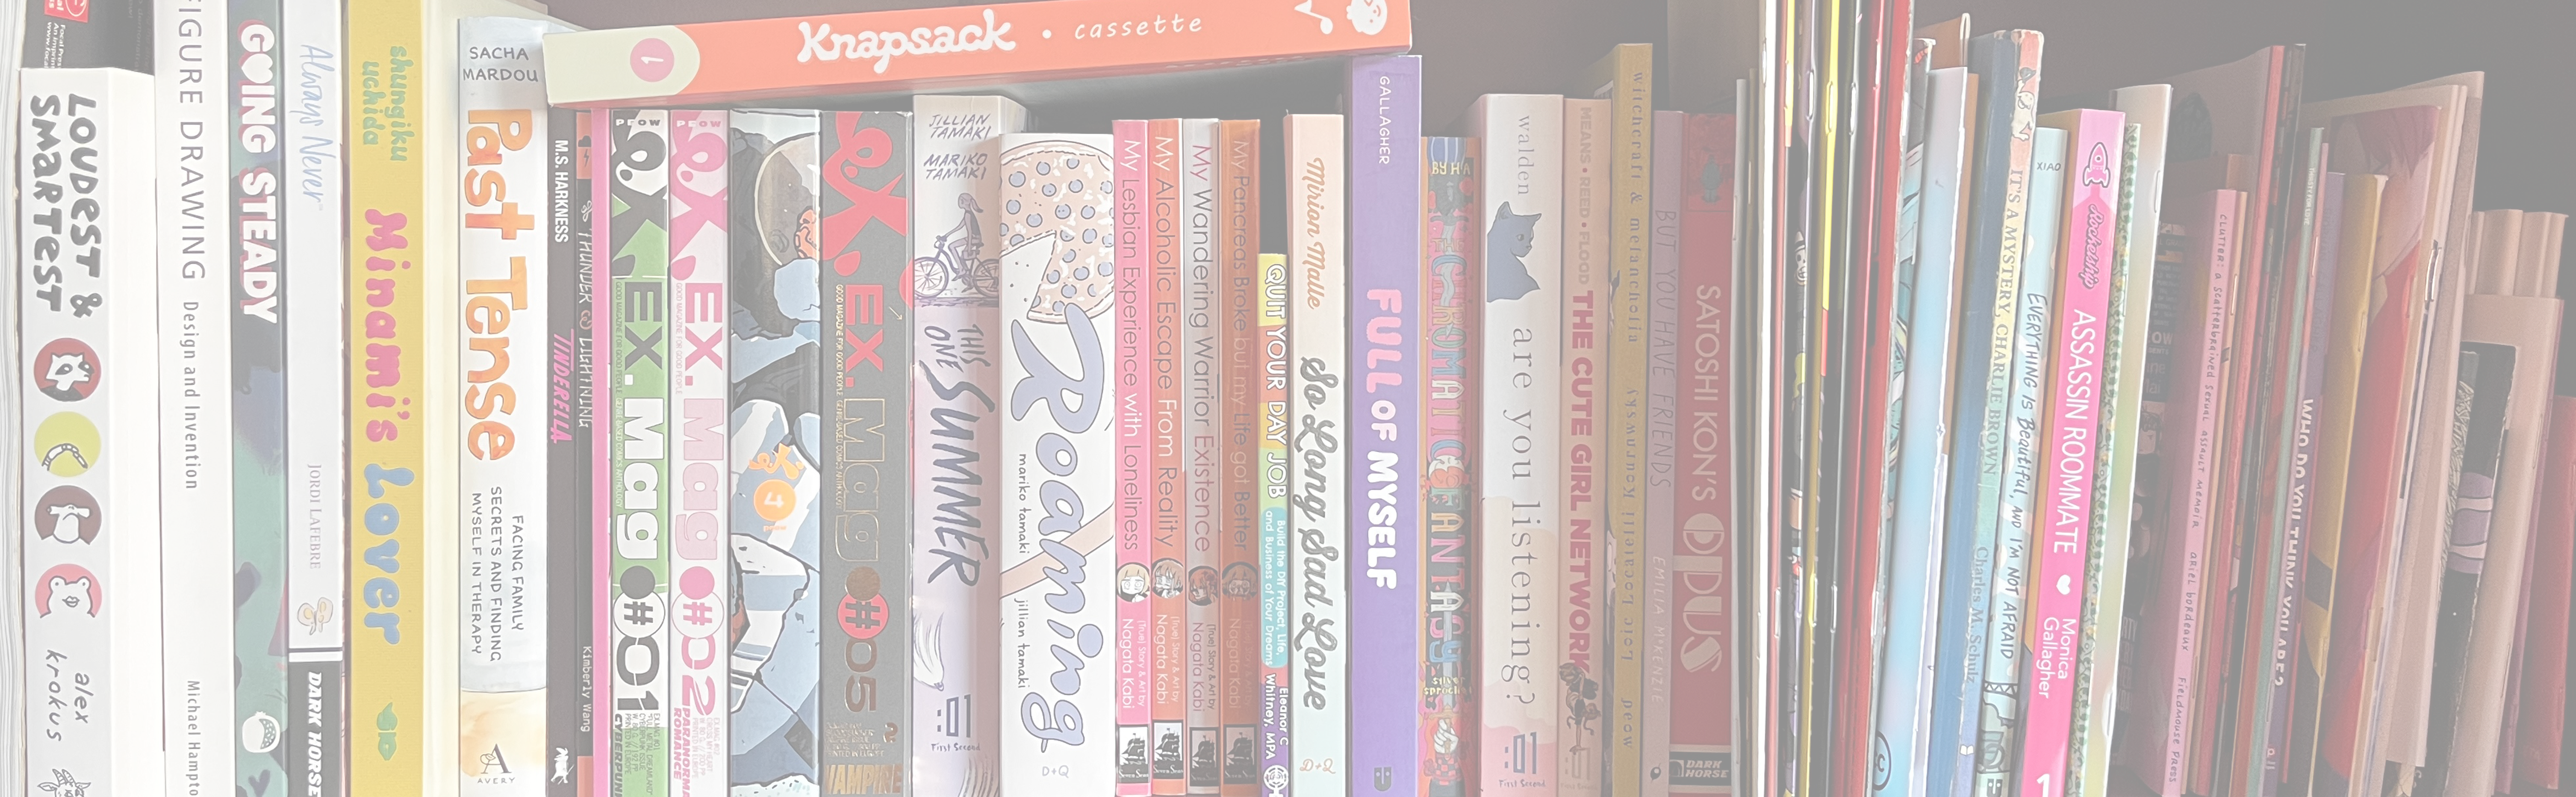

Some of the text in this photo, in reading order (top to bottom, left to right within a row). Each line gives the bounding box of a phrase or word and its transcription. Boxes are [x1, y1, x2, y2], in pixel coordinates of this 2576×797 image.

[463, 68, 538, 83] MARDOU
[469, 47, 528, 61] SACHA
[797, 8, 1016, 74] Knapsack
[1074, 12, 1203, 39] cassette
[290, 45, 336, 204] Always Never
[363, 62, 386, 145] uchida
[385, 46, 415, 161] shungiku
[929, 114, 990, 127] JILLIAN
[929, 126, 991, 139] TAMAKI
[1379, 76, 1390, 165] GALLAGHER
[1518, 115, 1534, 195] walden
[180, 121, 205, 279] DRAWING
[555, 139, 569, 243] M.S. HARKNESS
[924, 153, 987, 166] MARIKO
[925, 167, 987, 180] TAMAKI
[1579, 106, 1592, 285] MEANS REED FLOOD
[1628, 72, 1643, 343] witchcraft melancholia
[2036, 162, 2061, 170] XIAO
[238, 167, 278, 323] STEADY
[465, 109, 534, 460] Past Tense
[1302, 157, 1325, 310] Mirion Malle
[69, 294, 103, 318] &
[957, 323, 991, 367] THIS
[1119, 140, 1142, 550] My Lesbian Experience with Loneliness
[1152, 137, 1178, 547] My Alcoholic Escape From Reality
[1189, 145, 1215, 552] My Wandering Warrior Existence
[1231, 141, 1251, 551] My Pancreas Broke Life Better
[1650, 210, 1676, 488] BUT YOU HAVE FRIENDS
[1984, 170, 2023, 475] IT'S A MYSTERY, CHARLIE BROWN
[180, 301, 202, 490] Design and Invention
[363, 209, 415, 644] Minami's Lover
[550, 329, 574, 443] TINDERELLA
[1265, 264, 1287, 499] QUIT YOUR DAY JOB
[1692, 285, 1721, 501] SATOSHI KON'S
[2053, 309, 2096, 555] ASSASSIN ROOMMATE
[616, 398, 664, 560] Mag
[675, 398, 724, 560] Mag
[920, 325, 996, 587] ONE SUMMER
[1367, 289, 1402, 589] FULL OF MYSELF
[1569, 290, 1593, 673] THE CUTE GIRL NETWORK
[2000, 293, 2047, 659] EVERYTHING AND NOT AFRAID
[308, 463, 322, 569] JORDI LAFEBRE
[1011, 302, 1105, 753] Roaming
[1018, 453, 1032, 554] mariko tamaki
[1276, 520, 1286, 546] Build
[1292, 356, 1339, 710] So Long Sad Love
[1501, 328, 1540, 704] are you listening?
[472, 493, 482, 655] MYSELF IN THERAPY
[490, 486, 502, 662] SECRETS AND FINDING
[513, 516, 524, 631] FACING FAMILY
[1264, 511, 1274, 665] and Business Your Dreams
[1276, 550, 1286, 567] the
[1276, 590, 1286, 630] Project,
[1652, 556, 1665, 616] EMILIA
[1014, 597, 1030, 688] jillian tamaki
[1119, 619, 1135, 709] Nagata Kabi
[1154, 614, 1169, 704] Nagata Kabi
[1190, 623, 1205, 711] Nagata Kabi
[1621, 617, 1633, 661] Loic
[1966, 546, 1989, 684] Charles Schulz
[2036, 617, 2060, 699] Gallagher
[2057, 618, 2076, 680] Monica
[45, 649, 68, 741] krokus
[74, 672, 94, 723] alex
[186, 680, 200, 735] Michael
[308, 672, 322, 797] DARK HORSE
[581, 646, 592, 732] Kimberly Wang
[1263, 674, 1276, 759] Whitney, MPA
[1279, 688, 1288, 745] Eleanor C
[824, 764, 901, 794] VAMPIRE
[1042, 765, 1069, 777] D+Q
[1685, 769, 1729, 778] HORSE
[1686, 760, 1721, 769] DARK
